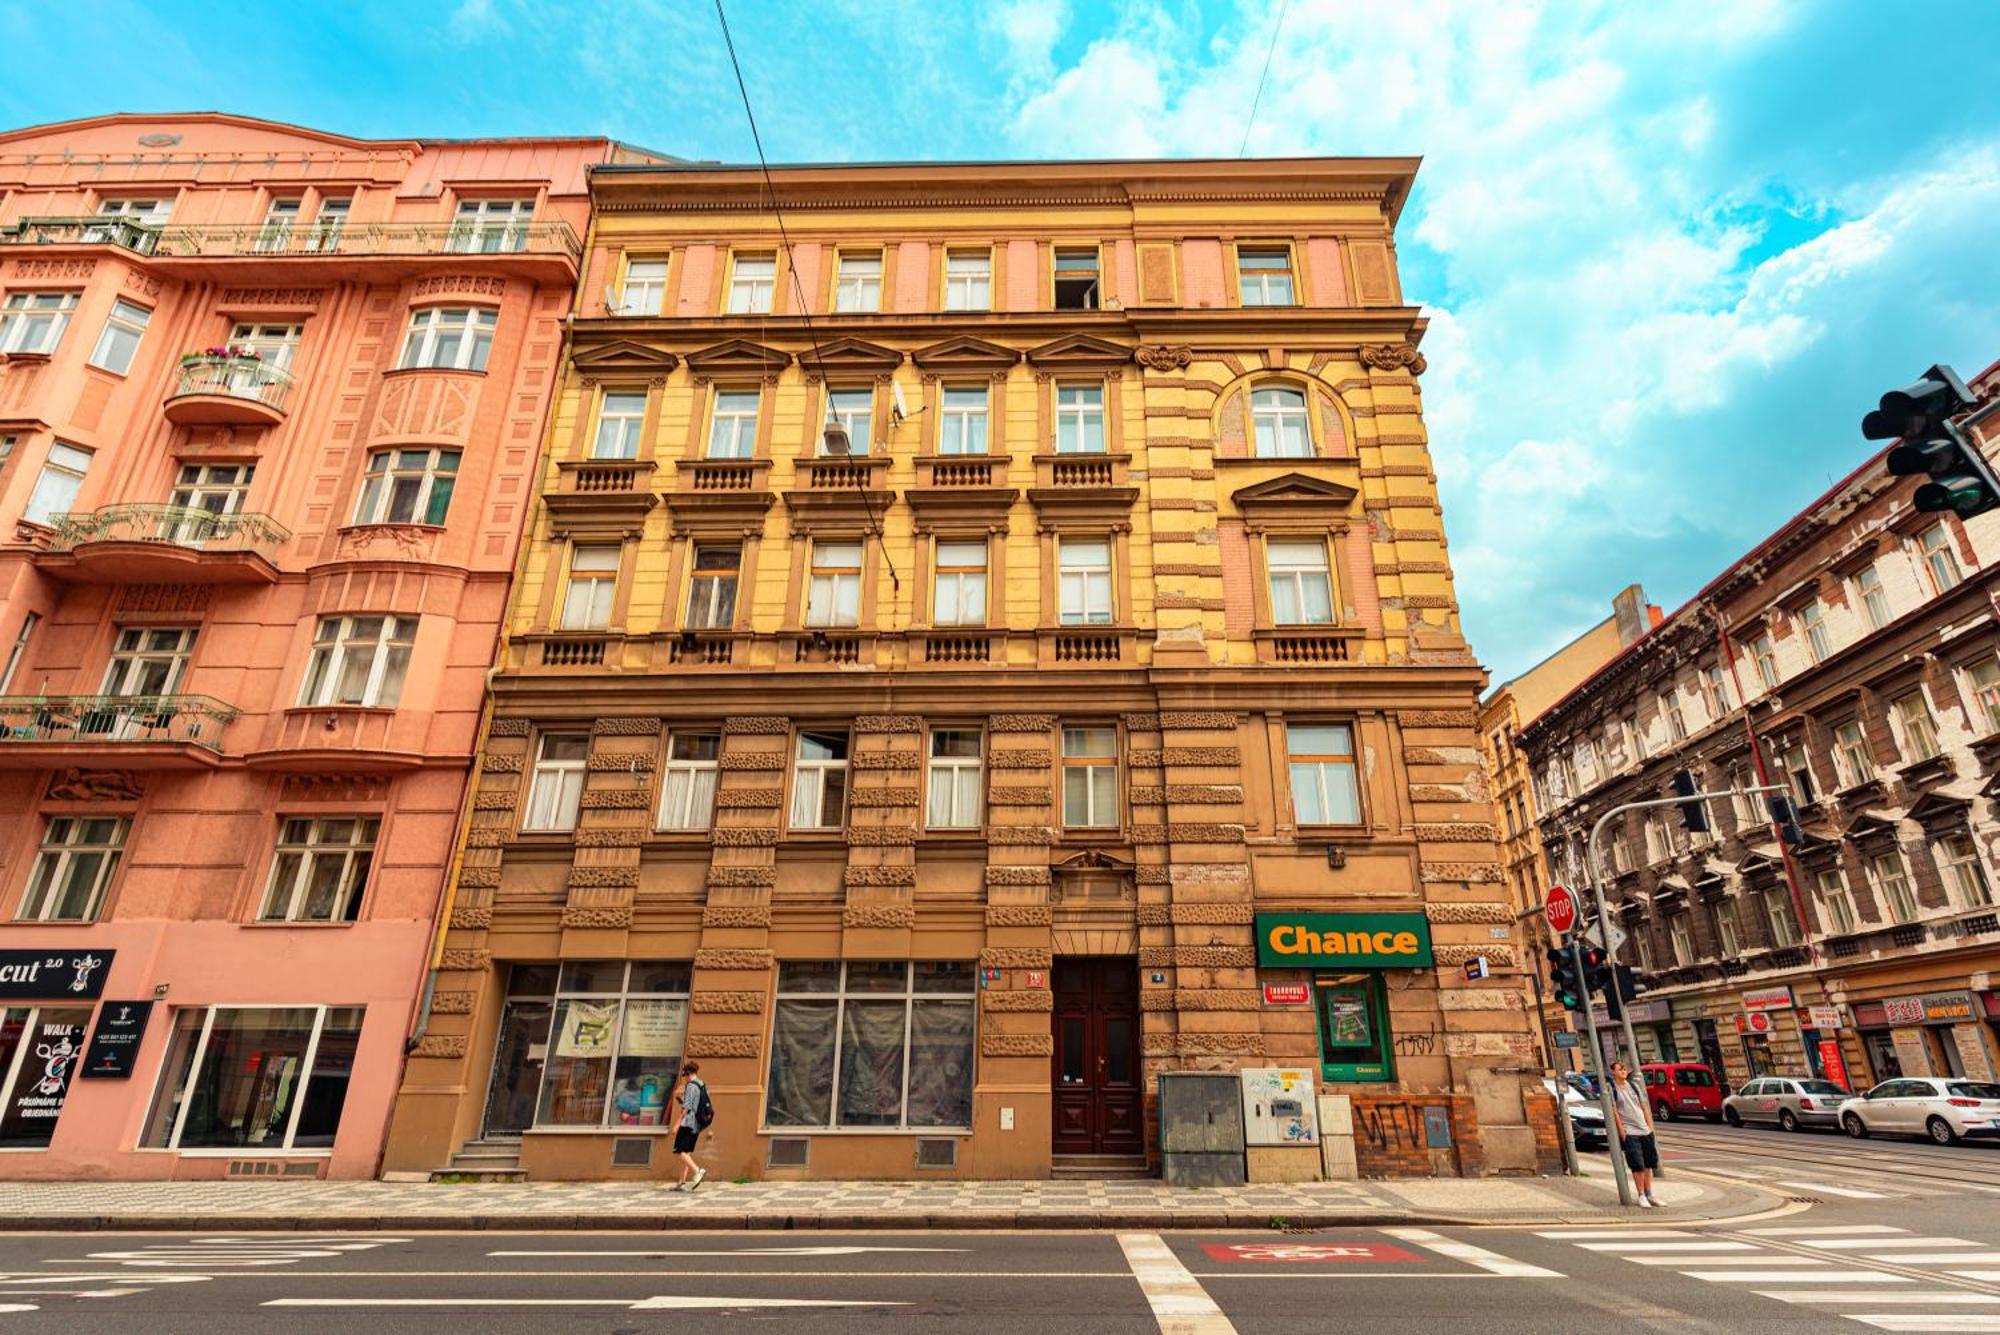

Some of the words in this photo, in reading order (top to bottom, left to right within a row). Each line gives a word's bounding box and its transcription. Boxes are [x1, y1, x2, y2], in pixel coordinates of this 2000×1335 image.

[1547, 899, 1571, 920] STOP
[1269, 925, 1419, 954] Chance
[43, 1024, 73, 1036] WALK
